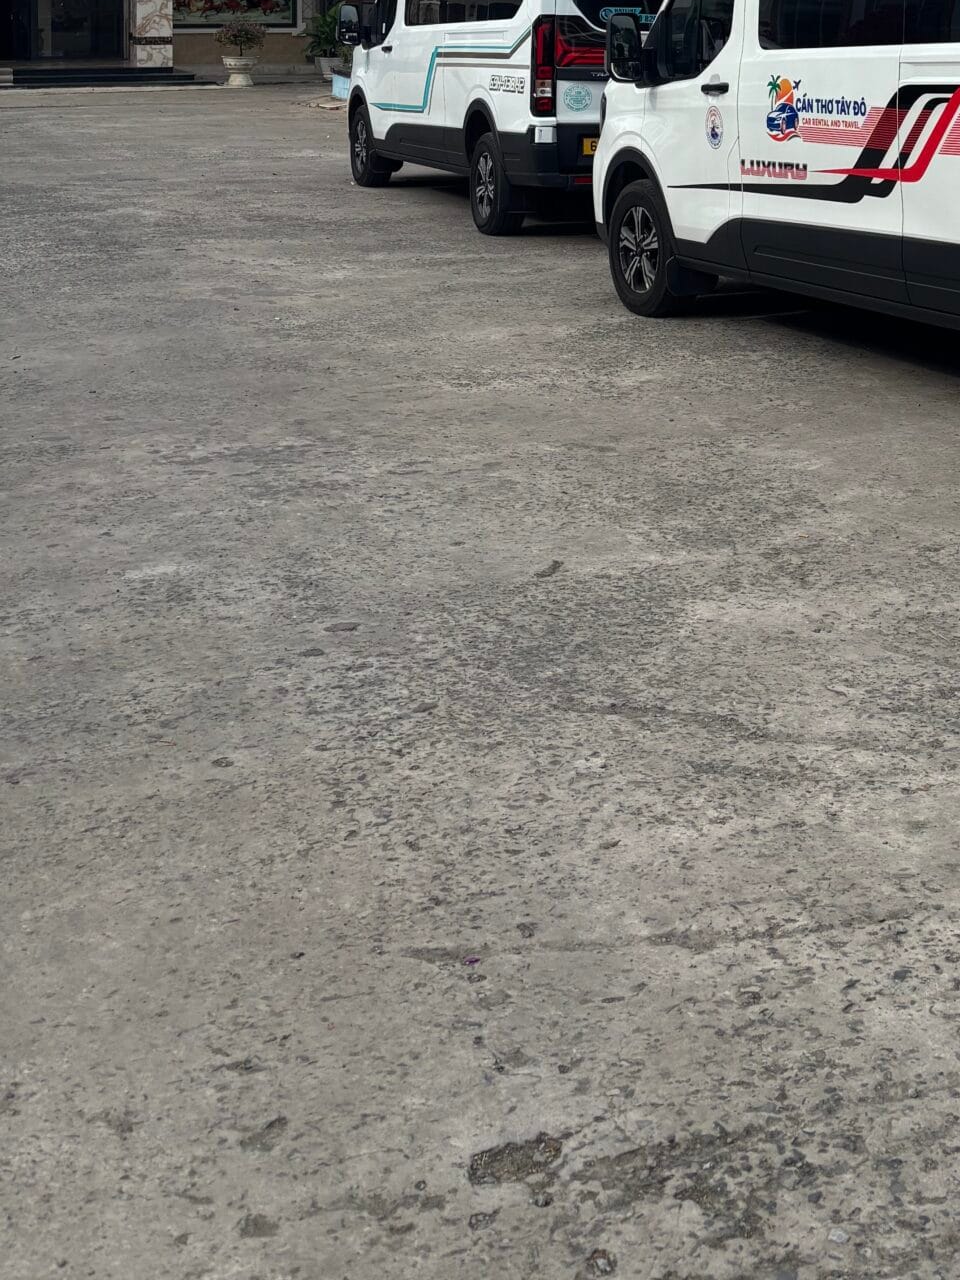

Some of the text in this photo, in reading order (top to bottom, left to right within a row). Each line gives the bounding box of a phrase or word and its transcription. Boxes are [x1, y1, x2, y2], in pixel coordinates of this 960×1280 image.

[815, 98, 834, 115] THƠ
[835, 95, 851, 116] TÂY
[852, 96, 867, 117] ĐÔ
[812, 118, 829, 127] RENTAL
[830, 119, 841, 128] AND
[842, 120, 860, 129] TRAVEL
[739, 158, 808, 181] LUXURY
